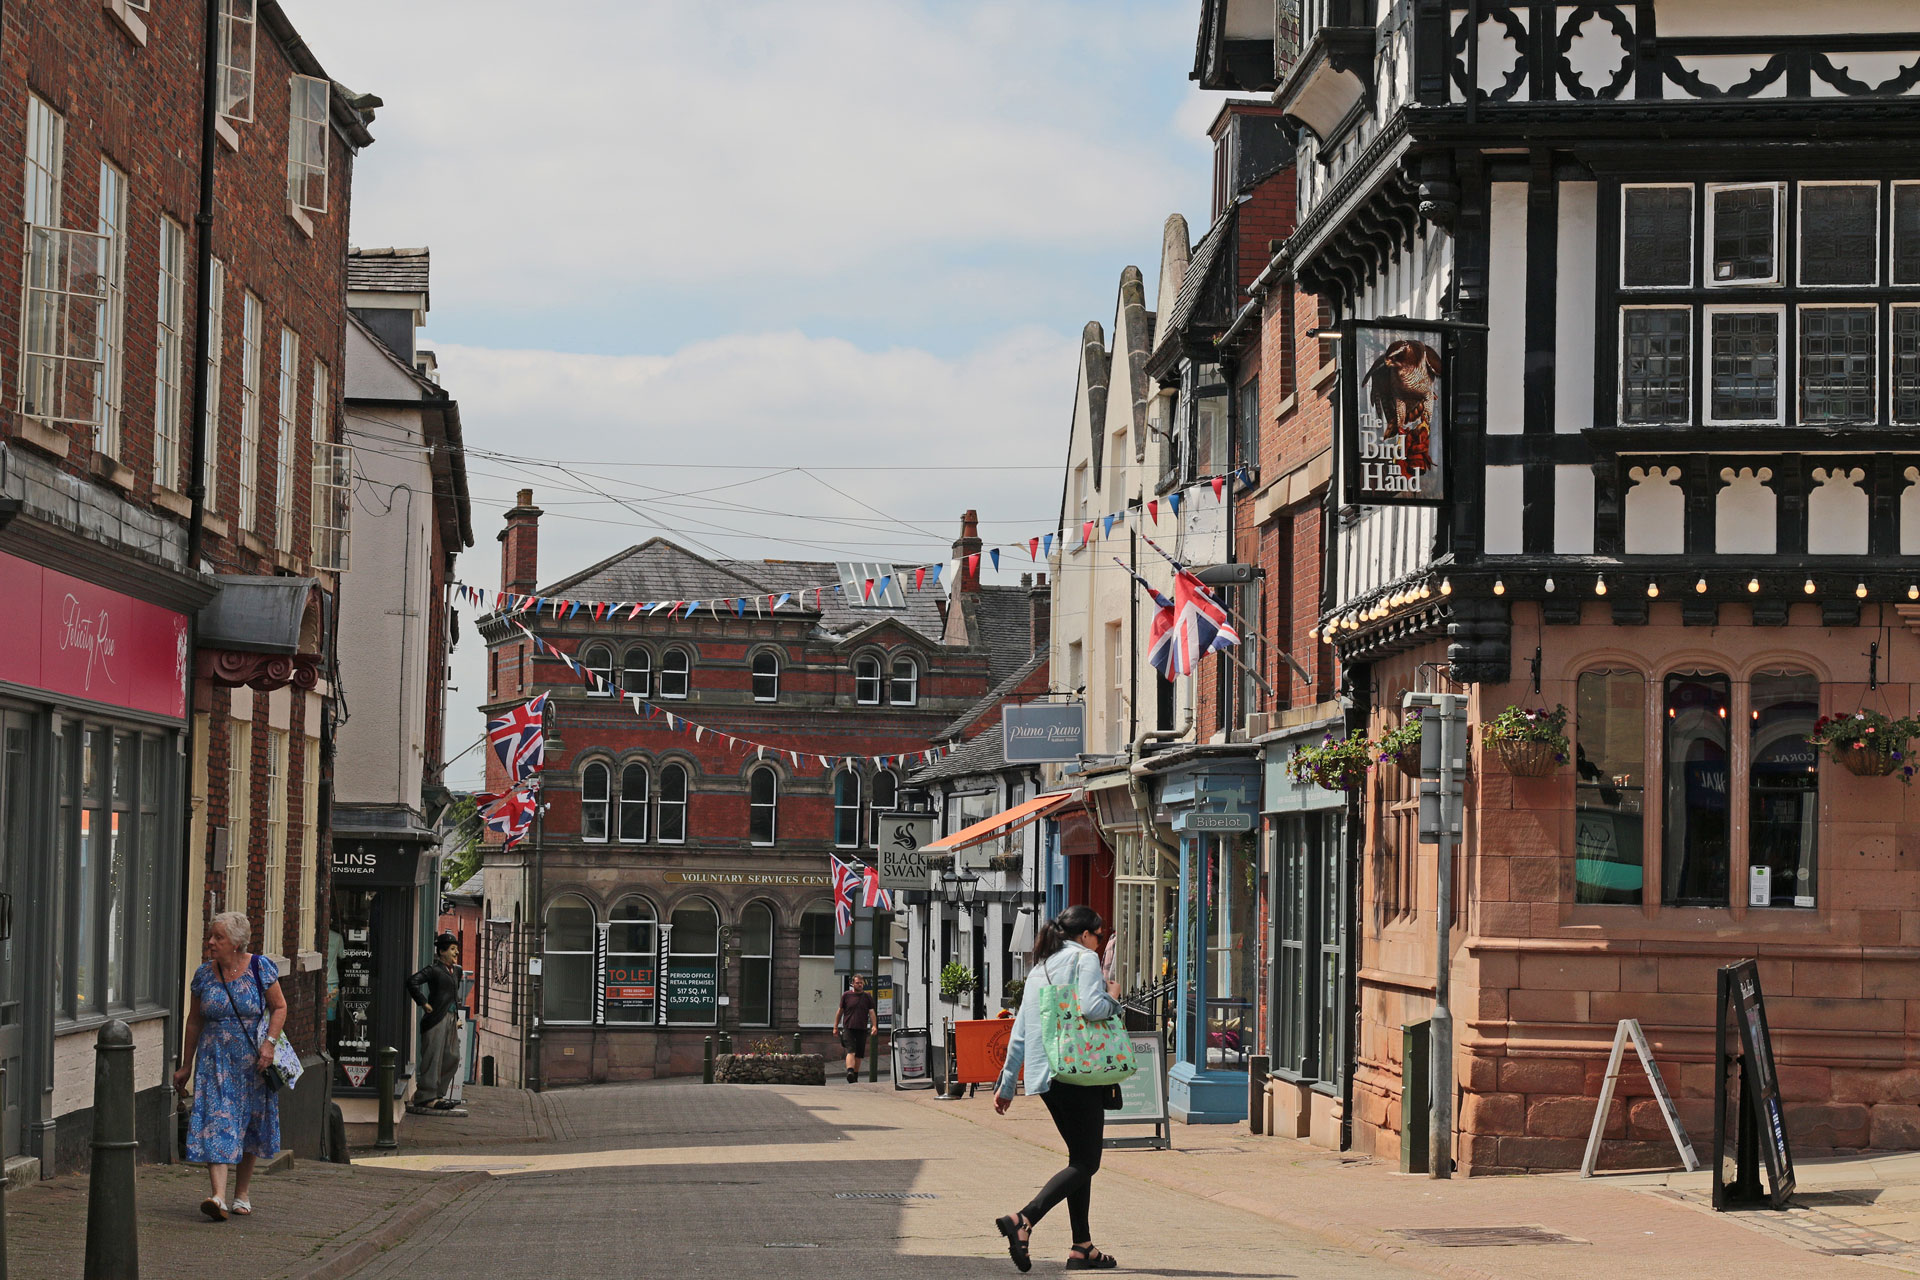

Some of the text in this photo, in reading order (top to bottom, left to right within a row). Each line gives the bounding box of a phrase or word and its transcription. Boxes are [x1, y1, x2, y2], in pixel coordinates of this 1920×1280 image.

[1361, 413, 1383, 429] The
[1361, 430, 1407, 460] Bird
[1387, 460, 1402, 476] in
[1361, 462, 1422, 493] Hand
[60, 592, 117, 692] Felicity Rose
[1196, 816, 1242, 827] Bibelot
[883, 851, 927, 866] BLACK
[883, 864, 927, 878] SWAN
[681, 873, 835, 884] VOLUNTARY SERVICES CENT
[342, 949, 373, 958] Superdry
[608, 969, 654, 981] TO LET
[677, 987, 687, 995] 517
[670, 996, 689, 1004] (5,577
[346, 1066, 369, 1074] GUESS
